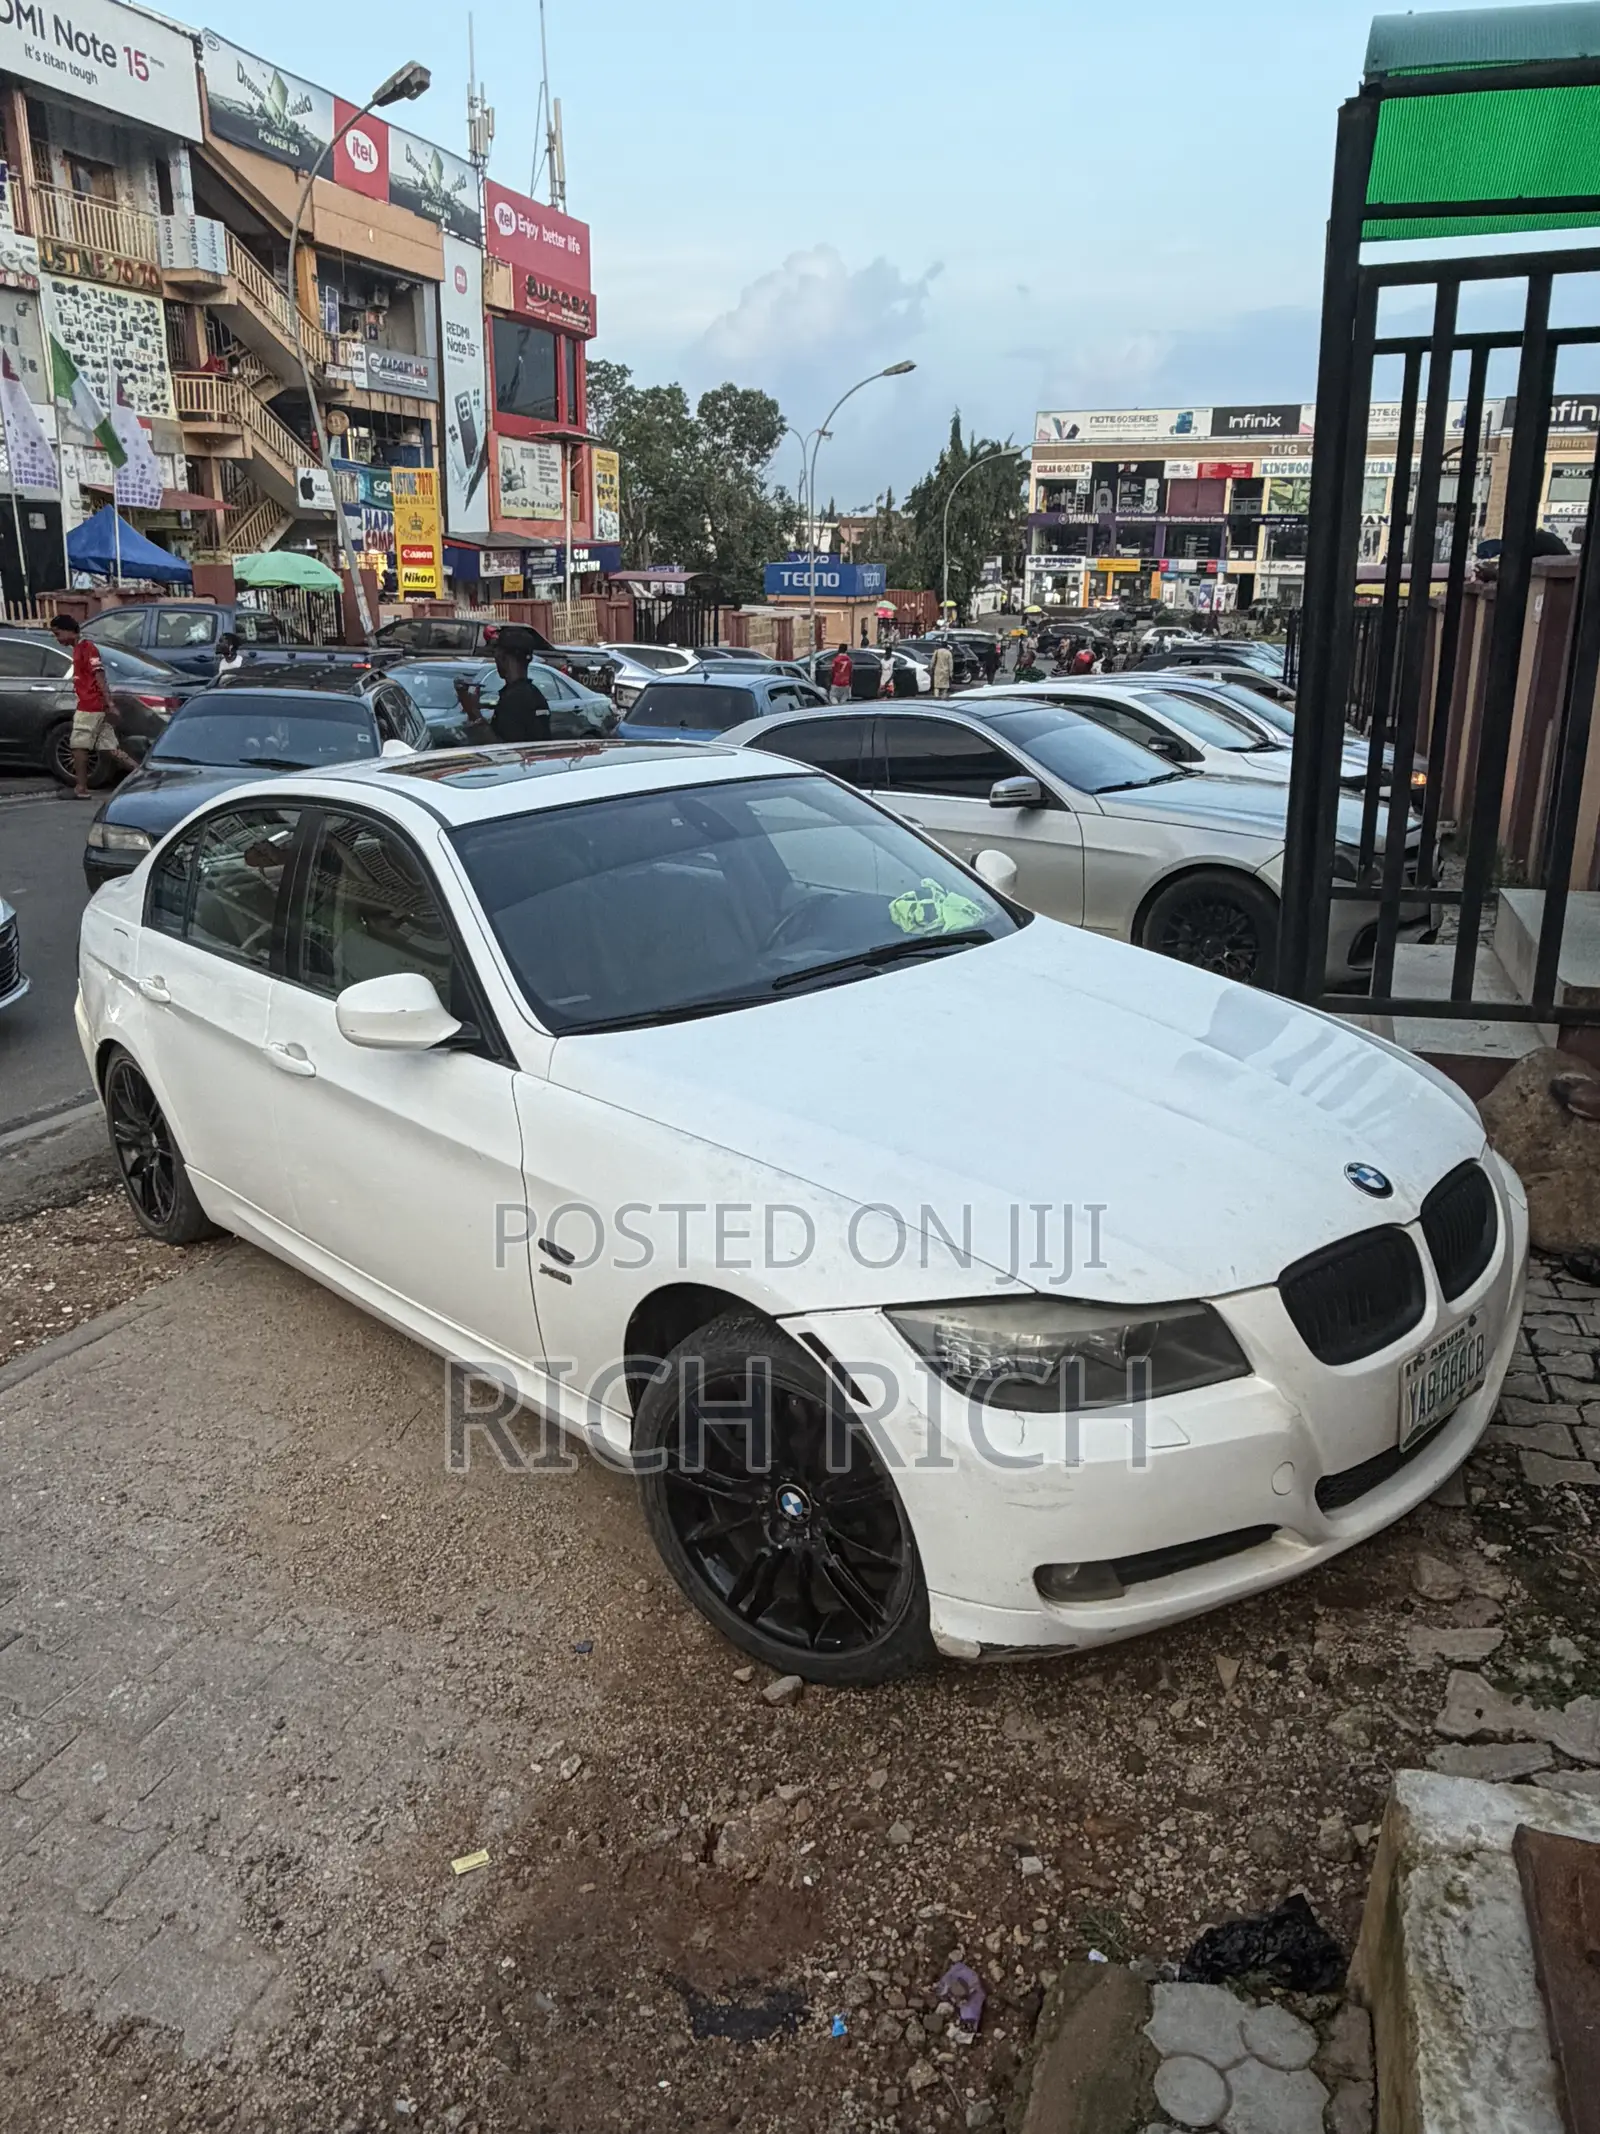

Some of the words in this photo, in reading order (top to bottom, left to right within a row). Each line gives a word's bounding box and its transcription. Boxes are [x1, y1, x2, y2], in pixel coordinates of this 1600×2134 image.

[53, 14, 117, 68] Note
[123, 46, 150, 82] 15
[25, 43, 41, 62] It's
[43, 52, 67, 73] titan
[69, 62, 98, 85] tough
[258, 128, 289, 152] POWER
[289, 143, 300, 156] 80
[352, 136, 374, 165] itel
[517, 212, 539, 241] Enjoy
[542, 224, 567, 249] better
[567, 235, 581, 255] life
[446, 321, 470, 340] REDMI
[446, 337, 467, 356] Note
[1128, 414, 1159, 423] SERIES
[1229, 413, 1282, 428] Infinix
[1269, 444, 1298, 455] TUG
[1262, 463, 1312, 475] KINGWOO
[1068, 514, 1099, 524] YAMAHA
[402, 549, 433, 559] Canon
[404, 572, 434, 583] Nikon
[780, 571, 840, 587] TECNO
